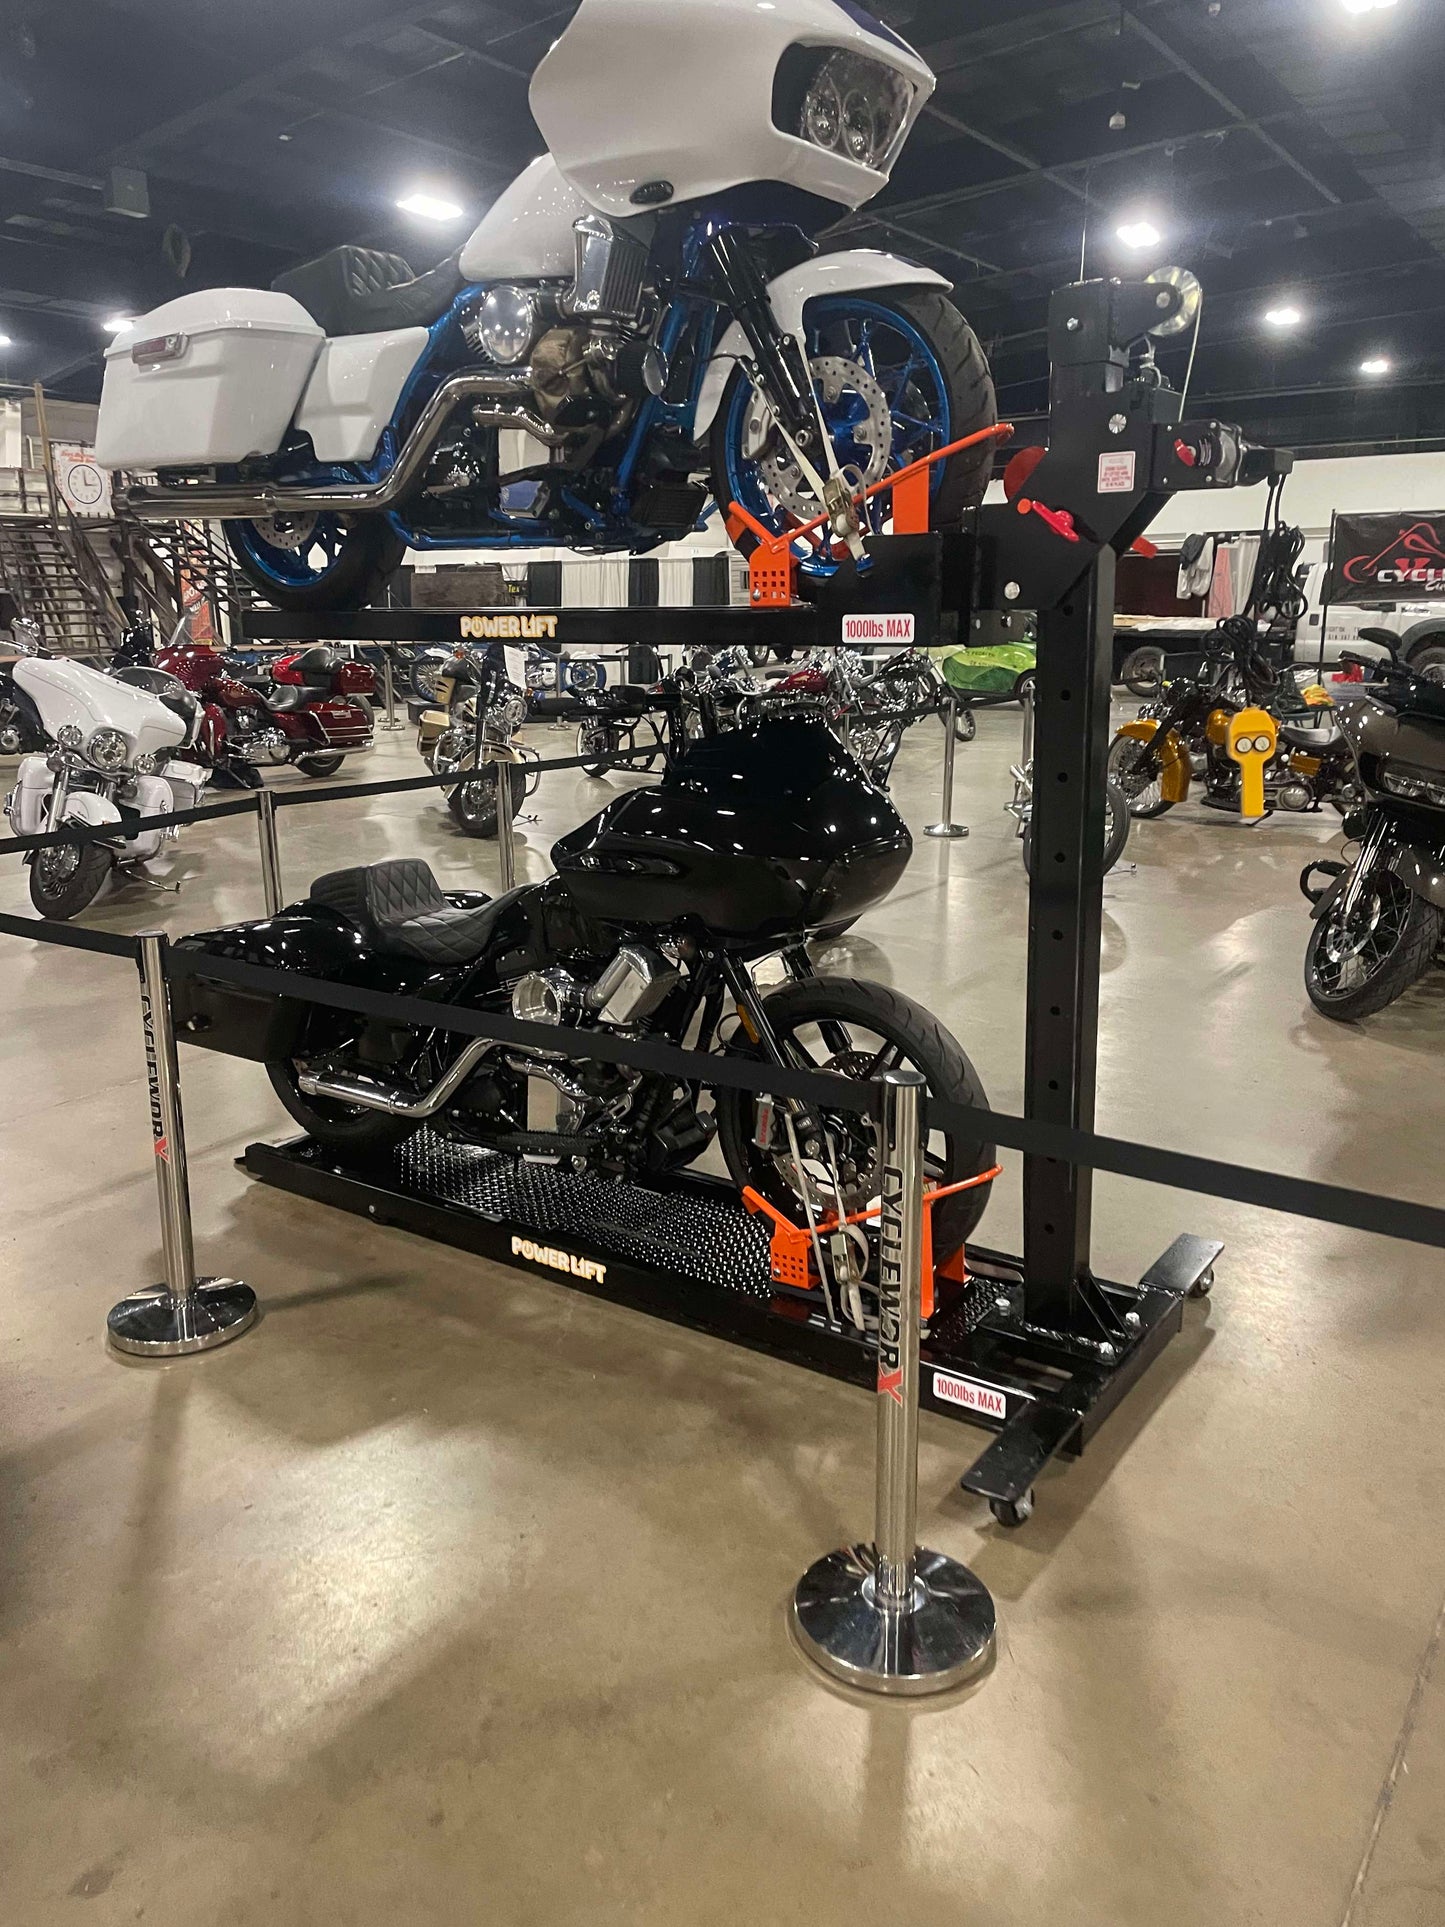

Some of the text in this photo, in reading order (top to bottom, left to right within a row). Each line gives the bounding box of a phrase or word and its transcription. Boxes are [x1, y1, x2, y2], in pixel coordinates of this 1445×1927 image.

[1377, 567, 1445, 583] CYCL
[460, 613, 558, 638] POWER LIFT
[845, 619, 911, 637] 1000lbs MAX
[511, 1235, 607, 1284] POWER LIFT
[936, 1378, 1002, 1413] 1000lbs MAX
